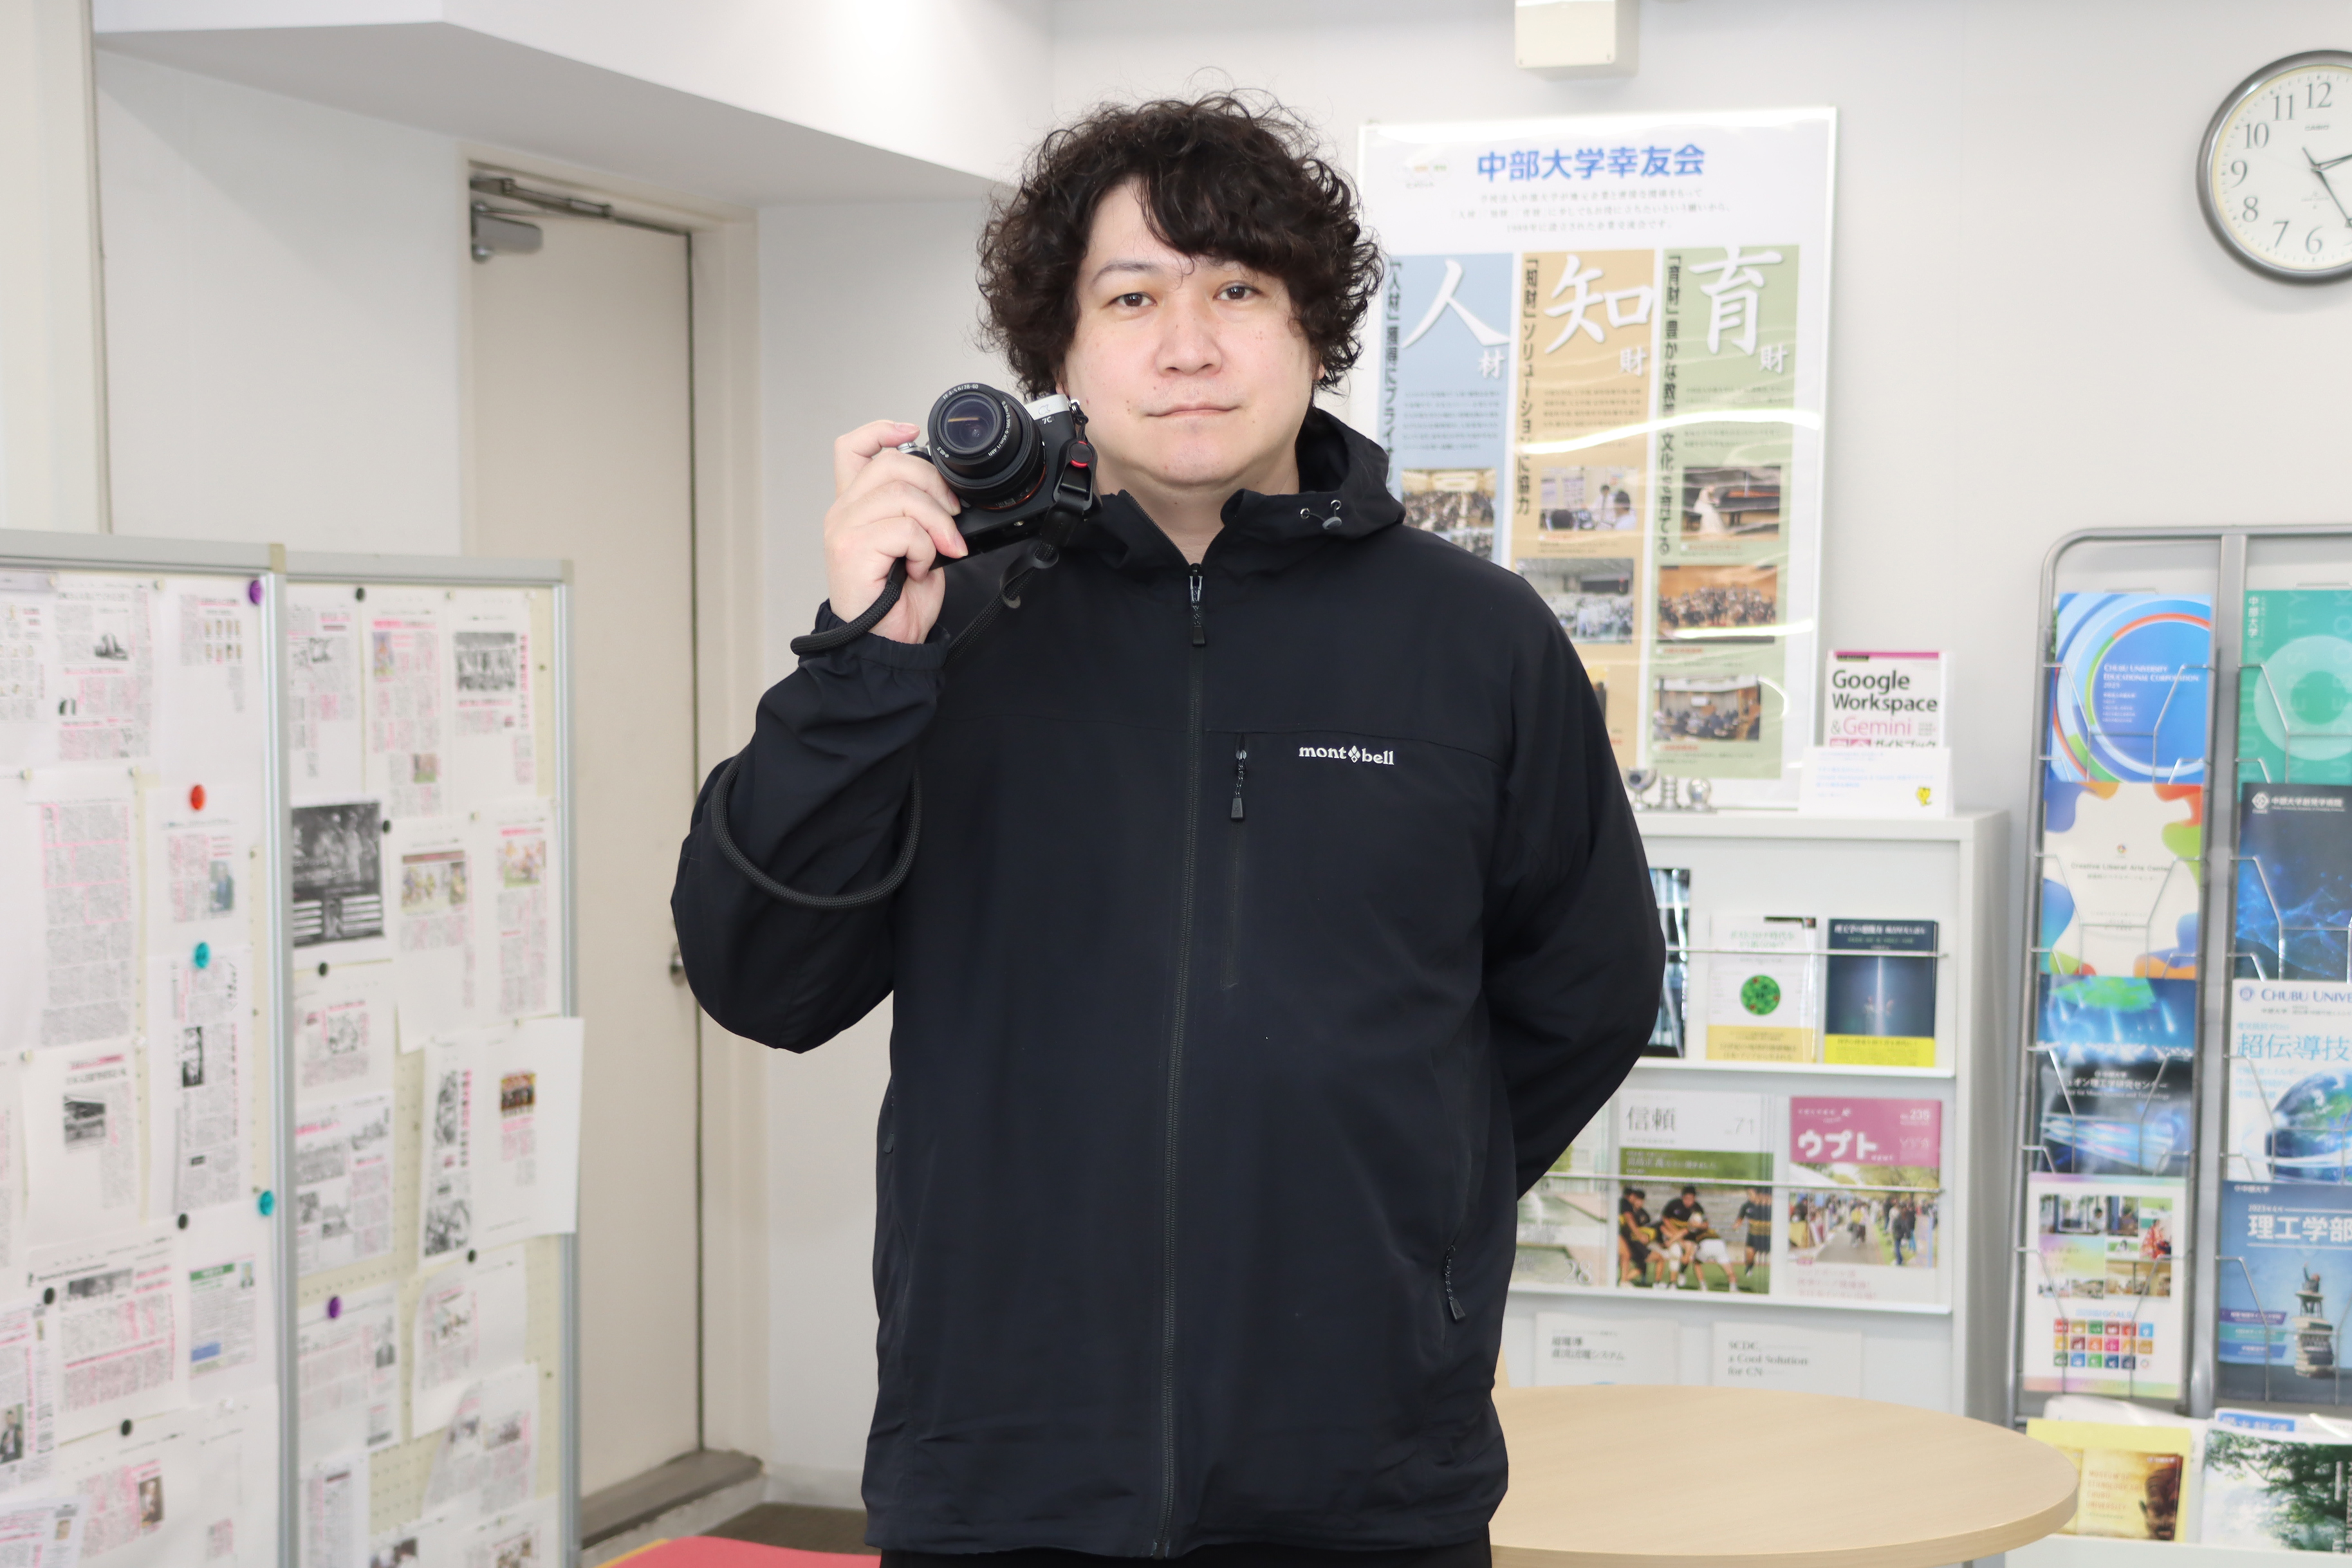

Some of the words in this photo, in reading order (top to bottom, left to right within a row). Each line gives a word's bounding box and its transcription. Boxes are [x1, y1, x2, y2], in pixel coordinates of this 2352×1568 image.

[2272, 95, 2295, 122] 11
[2306, 82, 2332, 109] 12
[2244, 123, 2270, 149] 10
[1477, 143, 1706, 183] 中部大学幸友会
[2230, 160, 2247, 188] 9
[2242, 196, 2259, 223] 8
[2273, 220, 2290, 248] 7
[2306, 226, 2324, 254] 6
[1401, 259, 1510, 349] 人
[1477, 350, 1505, 379] 材
[1544, 254, 1655, 355] 知
[1619, 346, 1648, 377] 財
[1688, 248, 1784, 356] 育
[1759, 344, 1788, 374] 財
[1041, 416, 1053, 425] 7C
[2248, 596, 2259, 639] 中部大学
[1832, 669, 1910, 696] Google
[1831, 692, 1938, 715] Workspace
[1831, 719, 1841, 735] &
[1843, 715, 1912, 736] Gemini
[1299, 746, 1347, 759] mont
[1361, 748, 1394, 765] bell
[2261, 988, 2308, 1002] CHUBU
[2237, 1033, 2351, 1062] 超伝導技
[1626, 1105, 1676, 1131] 信頼
[1735, 1116, 1755, 1134] 71
[1798, 1129, 1878, 1159] ウプト
[2247, 1214, 2352, 1242] 理工学部
[1563, 1259, 1593, 1284] 28
[1737, 1353, 1761, 1363] Cool
[1765, 1354, 1808, 1365] Solution
